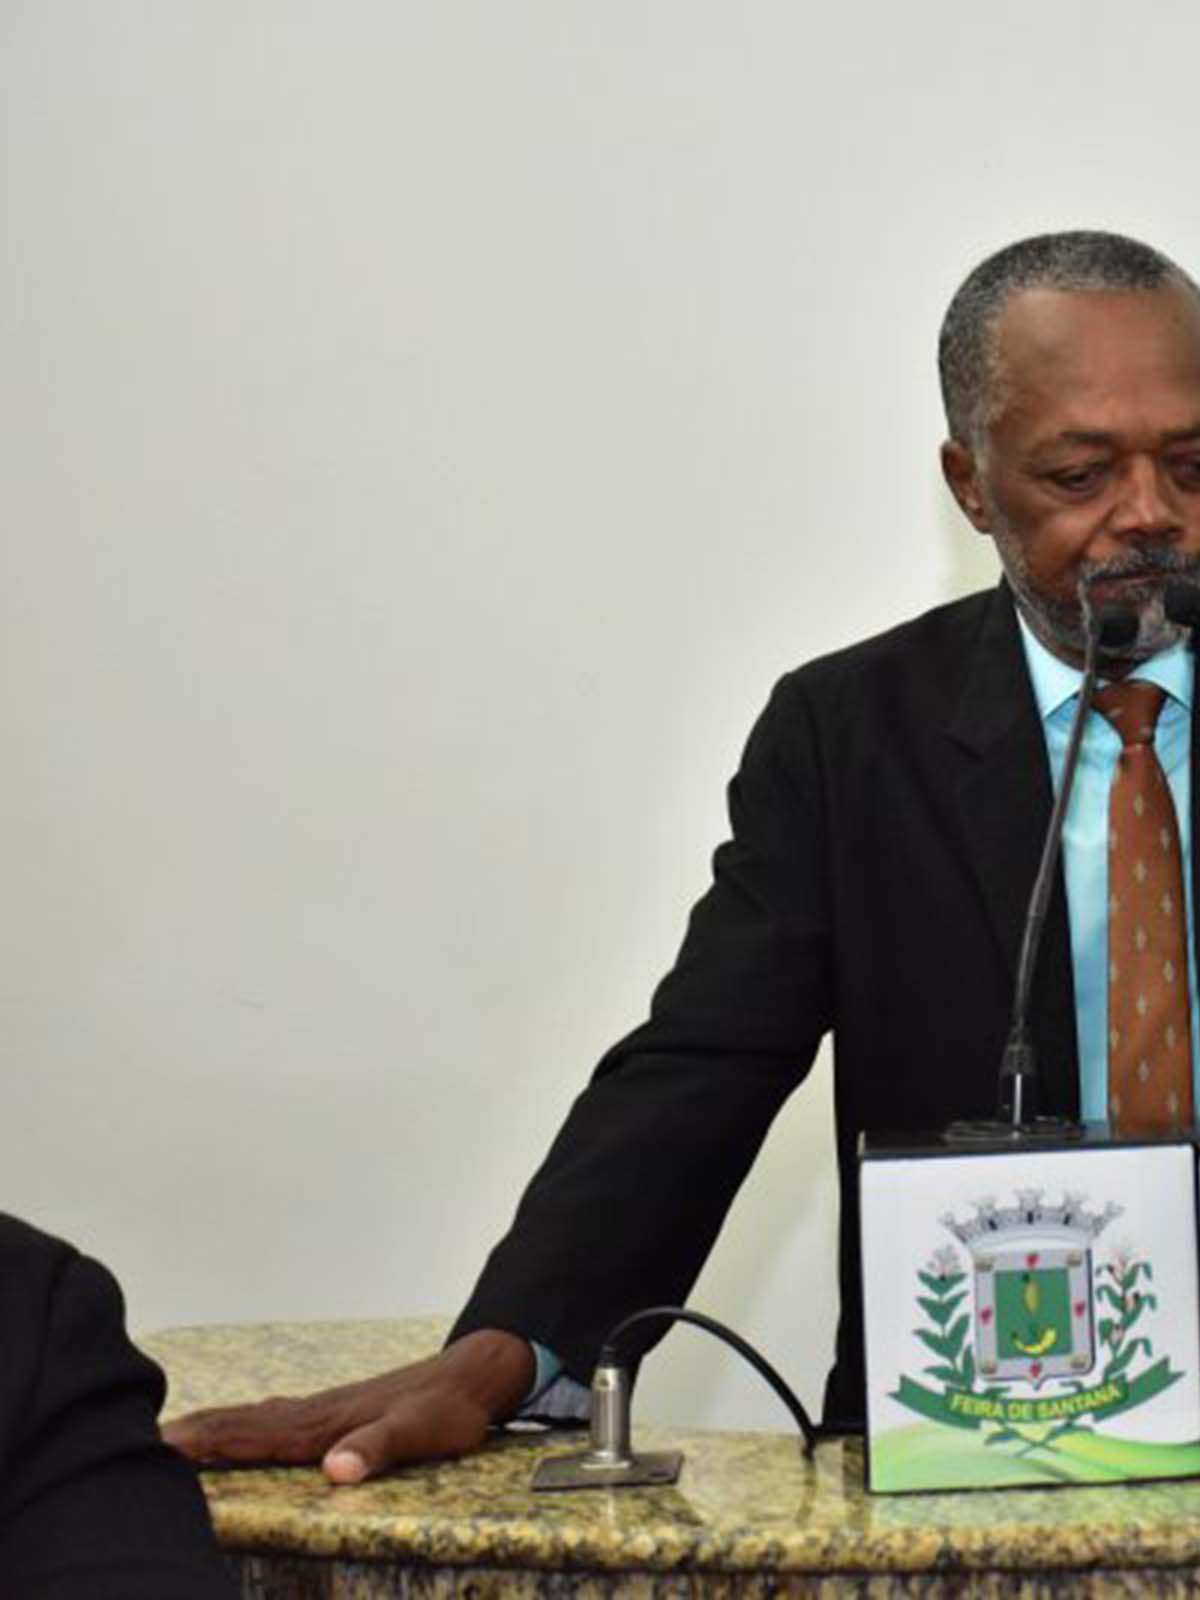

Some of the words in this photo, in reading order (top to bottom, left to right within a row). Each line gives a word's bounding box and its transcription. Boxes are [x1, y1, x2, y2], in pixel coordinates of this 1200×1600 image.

[950, 1391, 1004, 1418] FEIRA
[1008, 1402, 1031, 1419] DE
[1037, 1382, 1121, 1418] SANTANA
